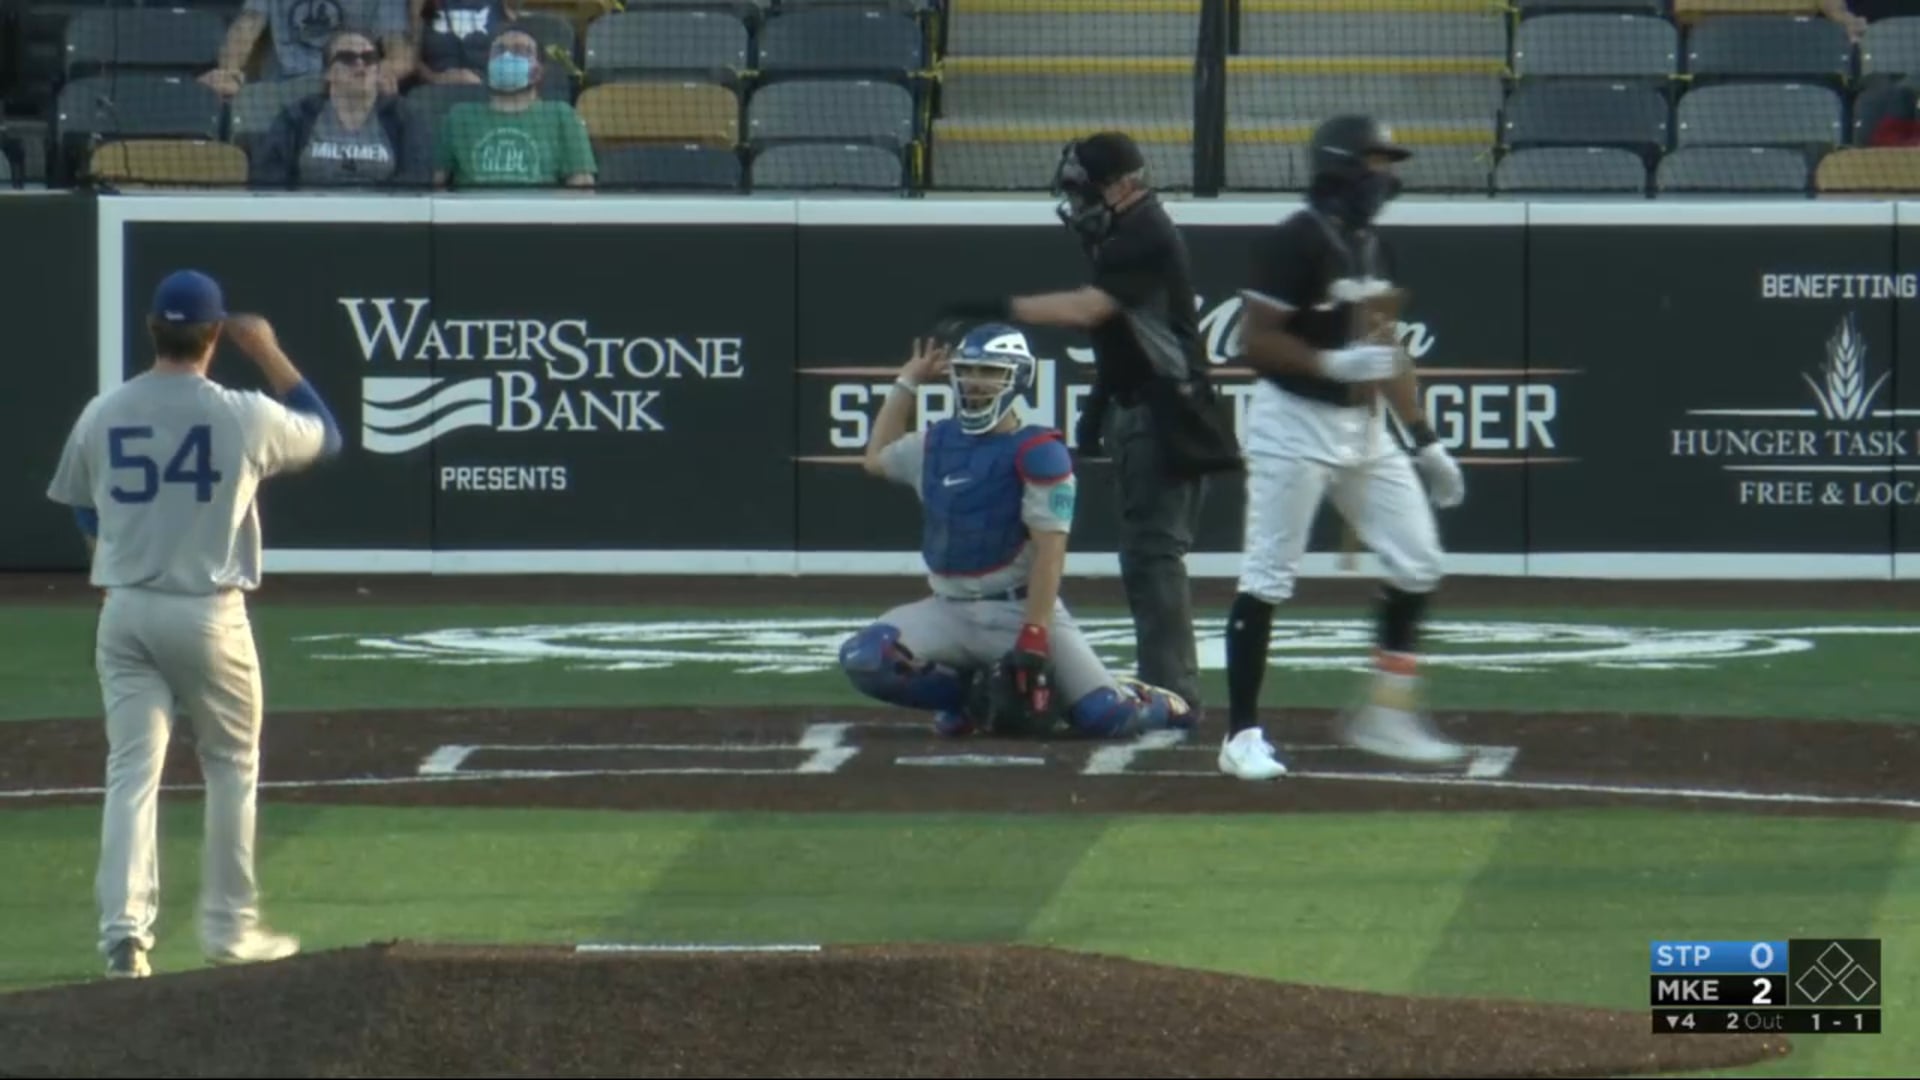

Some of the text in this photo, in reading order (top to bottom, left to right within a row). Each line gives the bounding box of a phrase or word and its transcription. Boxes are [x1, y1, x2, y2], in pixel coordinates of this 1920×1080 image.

[1762, 274, 1917, 298] BENEFITING
[1671, 430, 1817, 456] HUNGER
[1825, 430, 1907, 456] TASK
[108, 424, 221, 504] 54
[441, 467, 566, 490] PRESENTS
[1740, 482, 1813, 505] FREE
[1821, 482, 1844, 505] &
